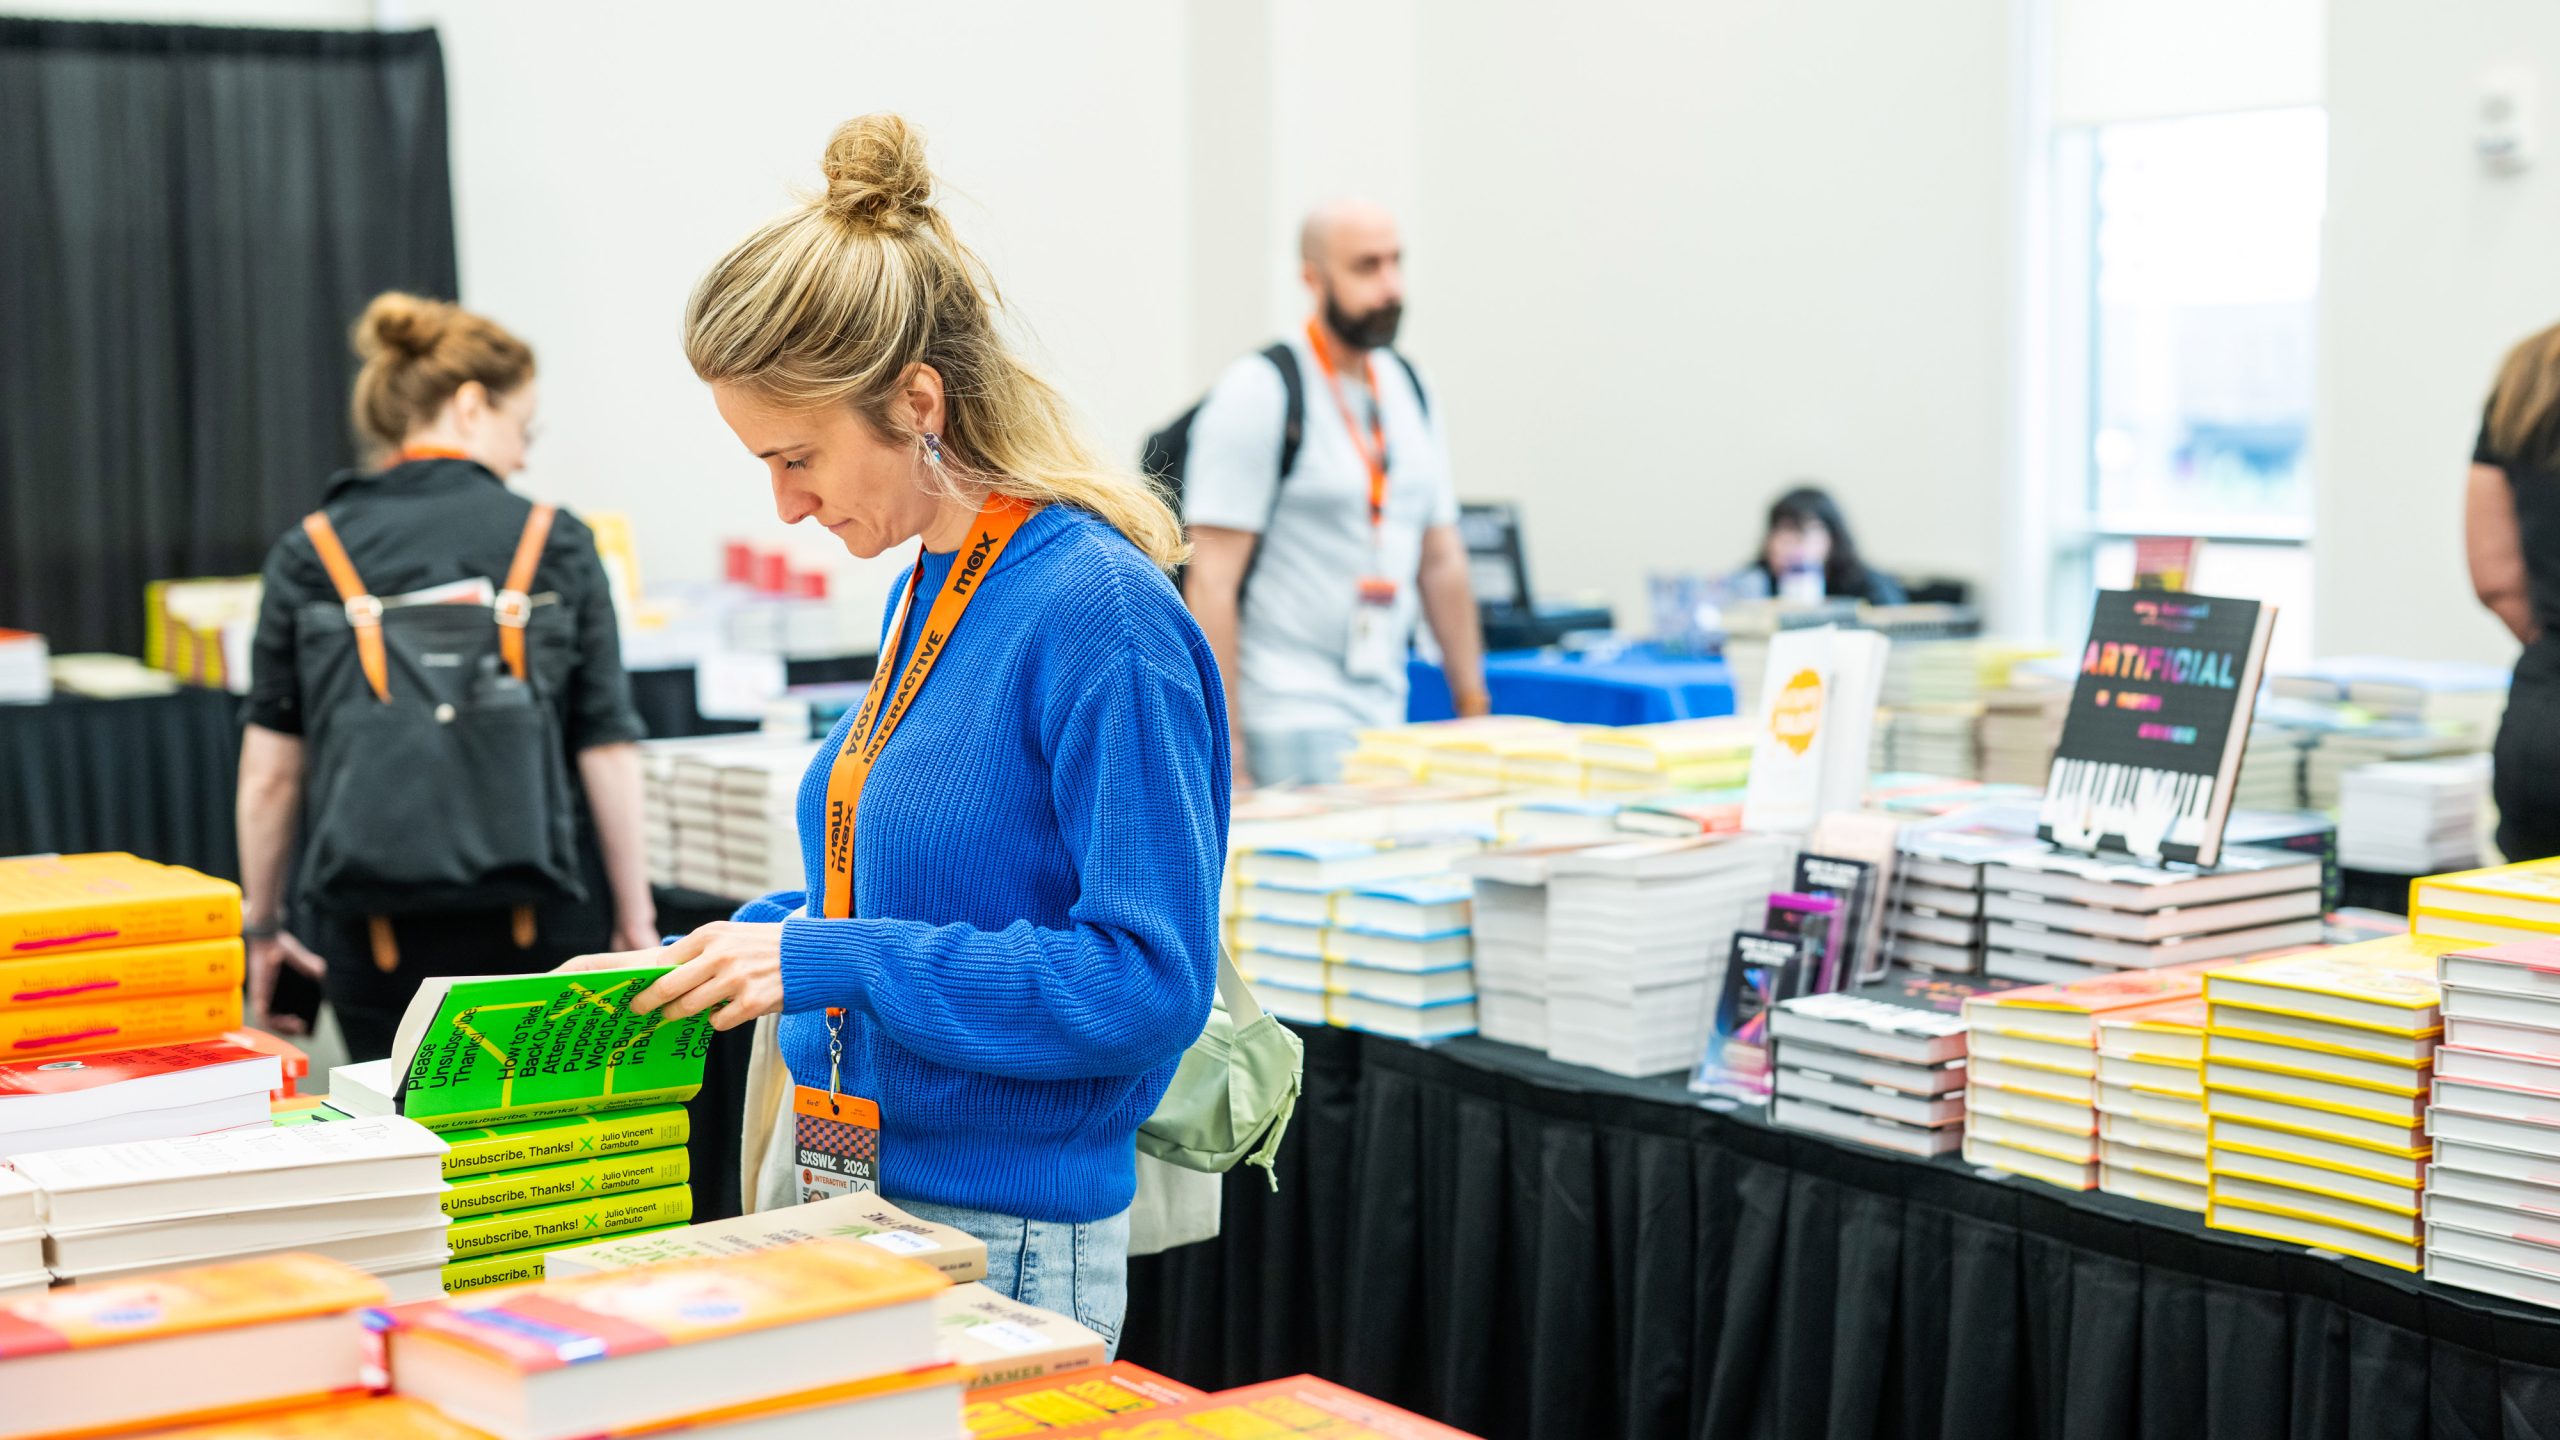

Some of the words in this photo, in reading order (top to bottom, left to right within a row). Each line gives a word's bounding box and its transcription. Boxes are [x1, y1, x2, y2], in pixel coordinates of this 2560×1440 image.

[953, 531, 999, 595] max
[2080, 640, 2236, 689] ARTIFICIAL
[863, 630, 944, 764] INTERACTIVE
[573, 989, 596, 1010] and
[514, 1006, 544, 1032] Take
[532, 1020, 556, 1041] Our
[584, 1029, 614, 1071] World
[601, 978, 646, 1028] Designed
[632, 1007, 663, 1049] Bullsh
[429, 1005, 482, 1088] Unsubscribe,
[508, 1032, 529, 1045] to
[562, 1018, 599, 1073] Purpose
[586, 1007, 606, 1017] in
[598, 997, 611, 1005] a
[612, 1020, 643, 1049] Bury
[671, 1028, 695, 1061] Julio
[407, 1043, 437, 1091] Please
[452, 1032, 487, 1087] Thanks!
[496, 1047, 521, 1080] How
[519, 1042, 547, 1078] Back
[607, 1051, 625, 1069] to
[627, 1050, 647, 1066] in
[451, 1112, 528, 1127] Unsubscribe,
[533, 1105, 579, 1117] Thanks!
[600, 1132, 620, 1142] Julio
[621, 1127, 654, 1138] Vincent
[600, 1139, 639, 1150] Gambuto
[449, 1149, 526, 1169] Unsubscribe,
[528, 1141, 574, 1158] Thanks!
[800, 1150, 829, 1169] SXSW
[844, 1159, 870, 1178] 2024
[601, 1171, 621, 1181] Julio
[622, 1166, 654, 1178] Vincent
[601, 1178, 640, 1190] Gambuto
[814, 1175, 848, 1188] INTERACTIVE
[451, 1188, 527, 1211] Unsubscribe,
[530, 1181, 576, 1199] Thanks!
[605, 1209, 625, 1219] Julio
[625, 1203, 657, 1215] Vincent
[605, 1215, 643, 1228] Gambuto
[456, 1226, 532, 1250] Unsubscribe,
[534, 1219, 579, 1236] Thanks!
[453, 1267, 531, 1291] Unsubscribe,
